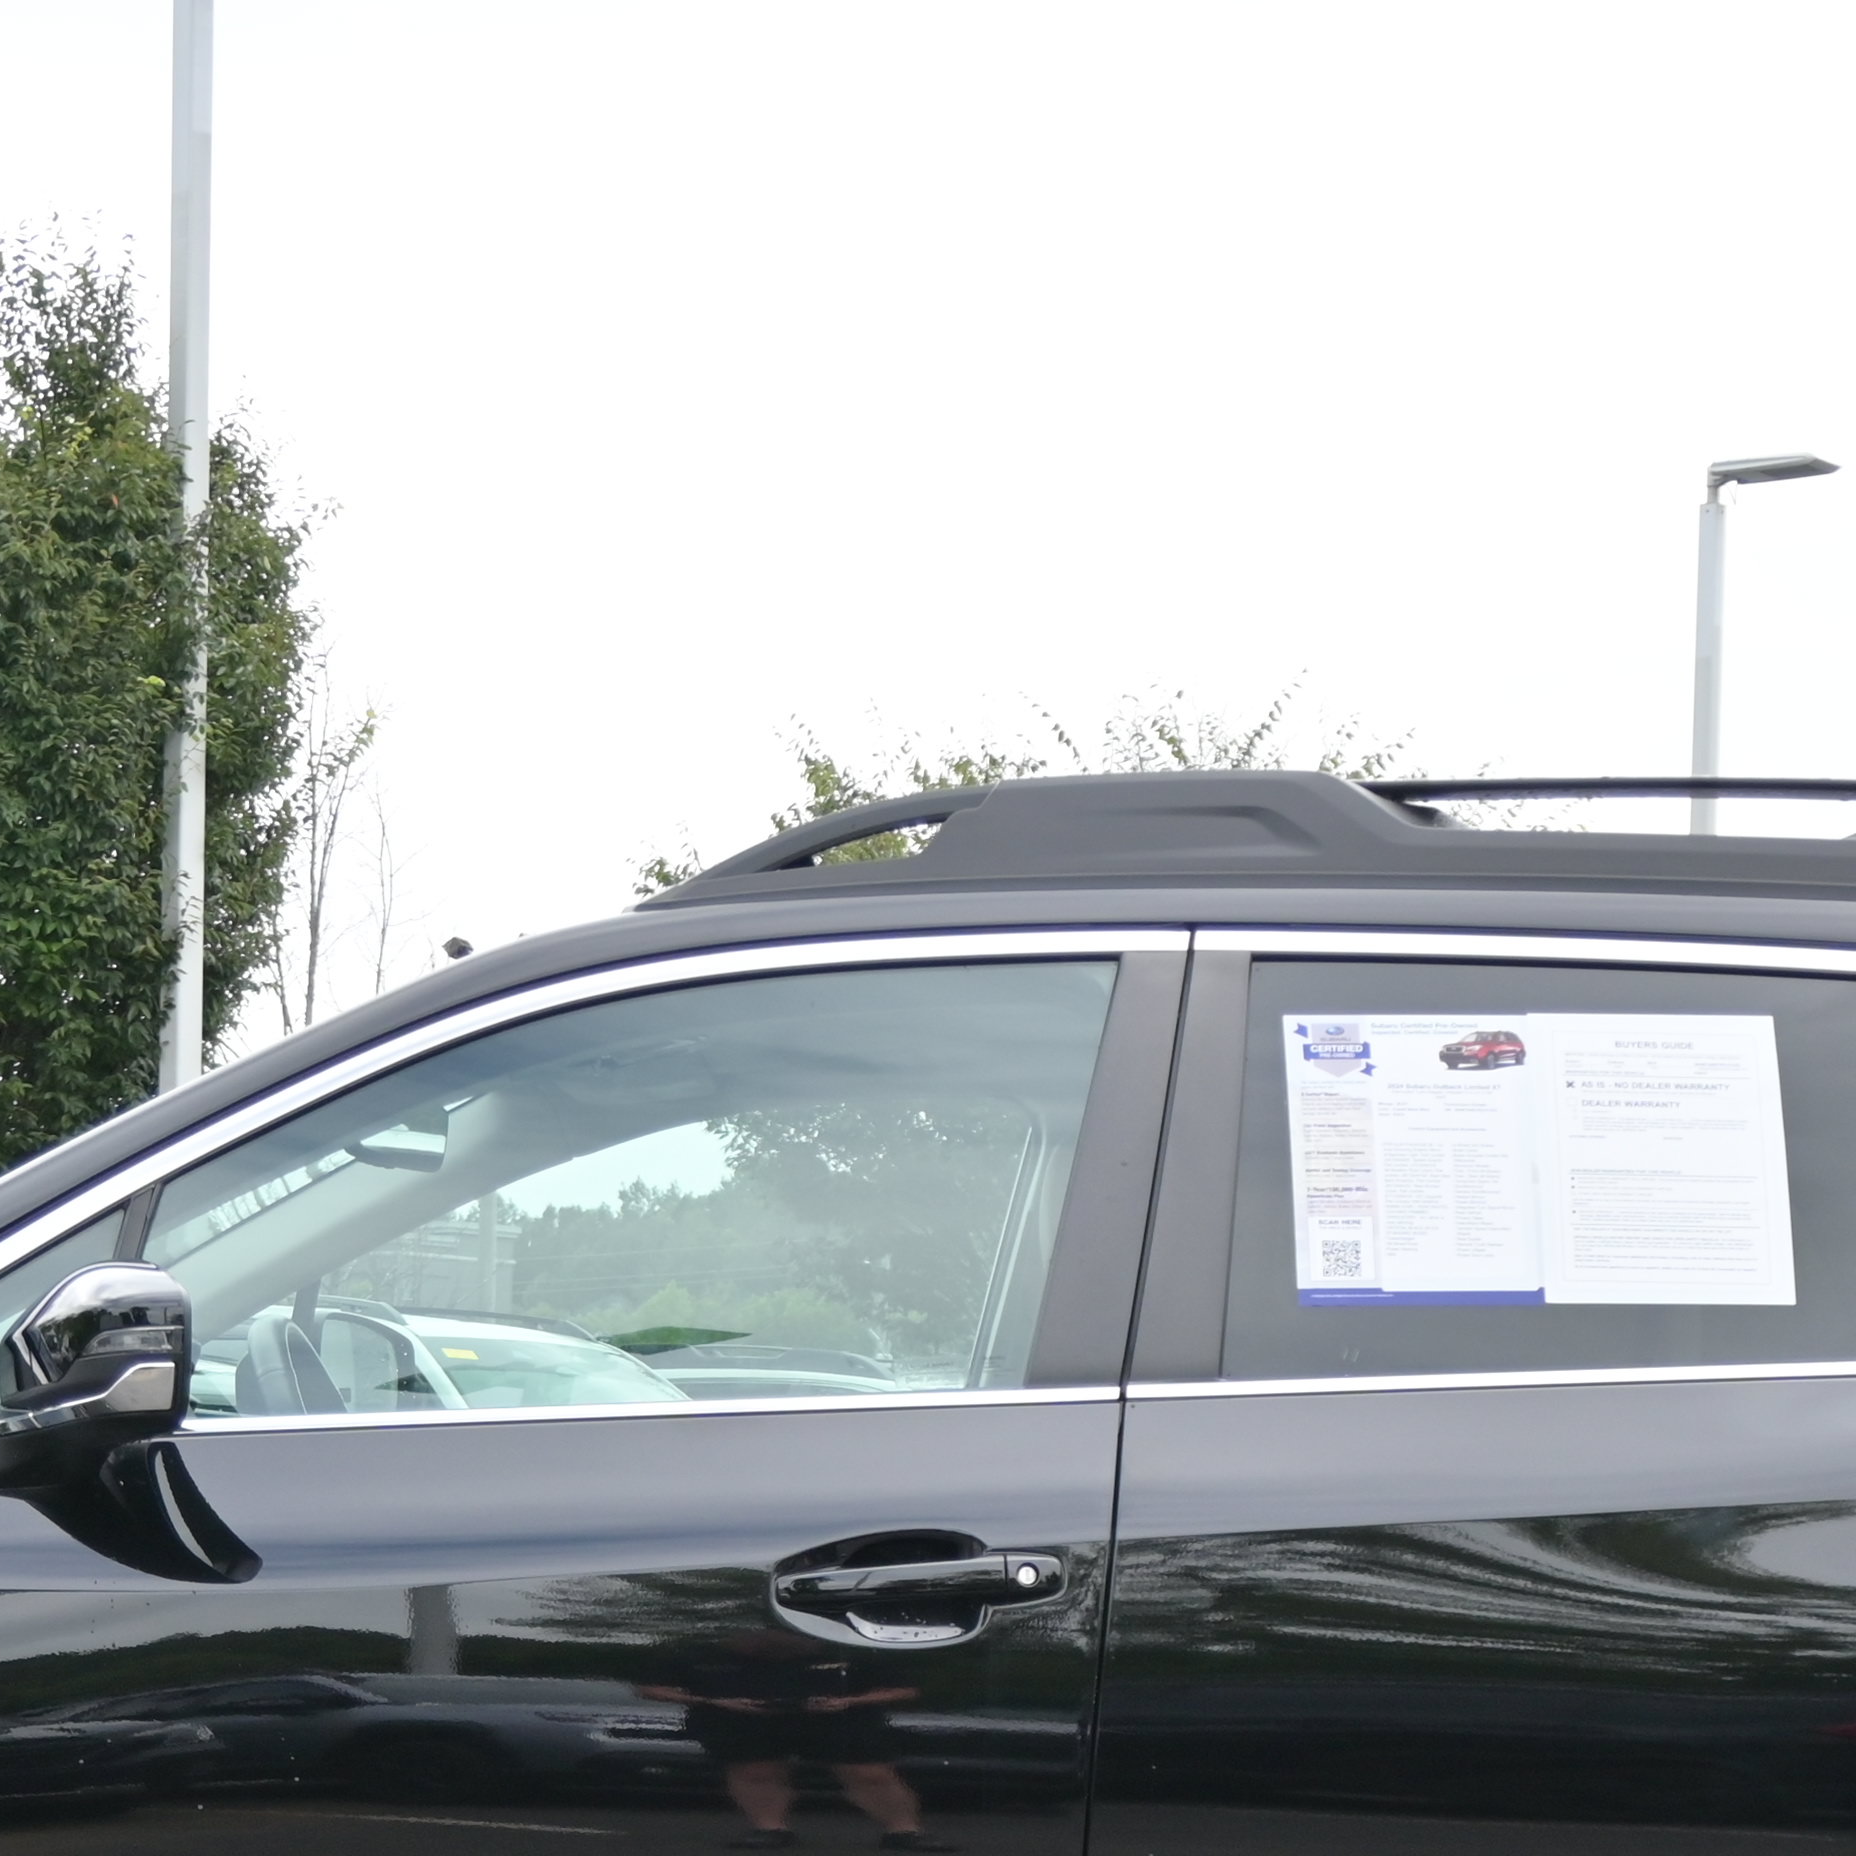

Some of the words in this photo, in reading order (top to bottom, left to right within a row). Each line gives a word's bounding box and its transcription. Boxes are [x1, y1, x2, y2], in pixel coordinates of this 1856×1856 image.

[1310, 1044, 1364, 1053] CERTIFIED
[1614, 1040, 1658, 1049] BUYERS
[1661, 1041, 1694, 1050] GUIDE
[1581, 1081, 1593, 1089] AS
[1596, 1081, 1605, 1089] IS
[1614, 1081, 1629, 1089] NO
[1631, 1081, 1671, 1090] DEALER
[1674, 1082, 1730, 1091] WARRANTY
[1581, 1098, 1622, 1107] DEALER
[1624, 1100, 1681, 1109] WARRANTY
